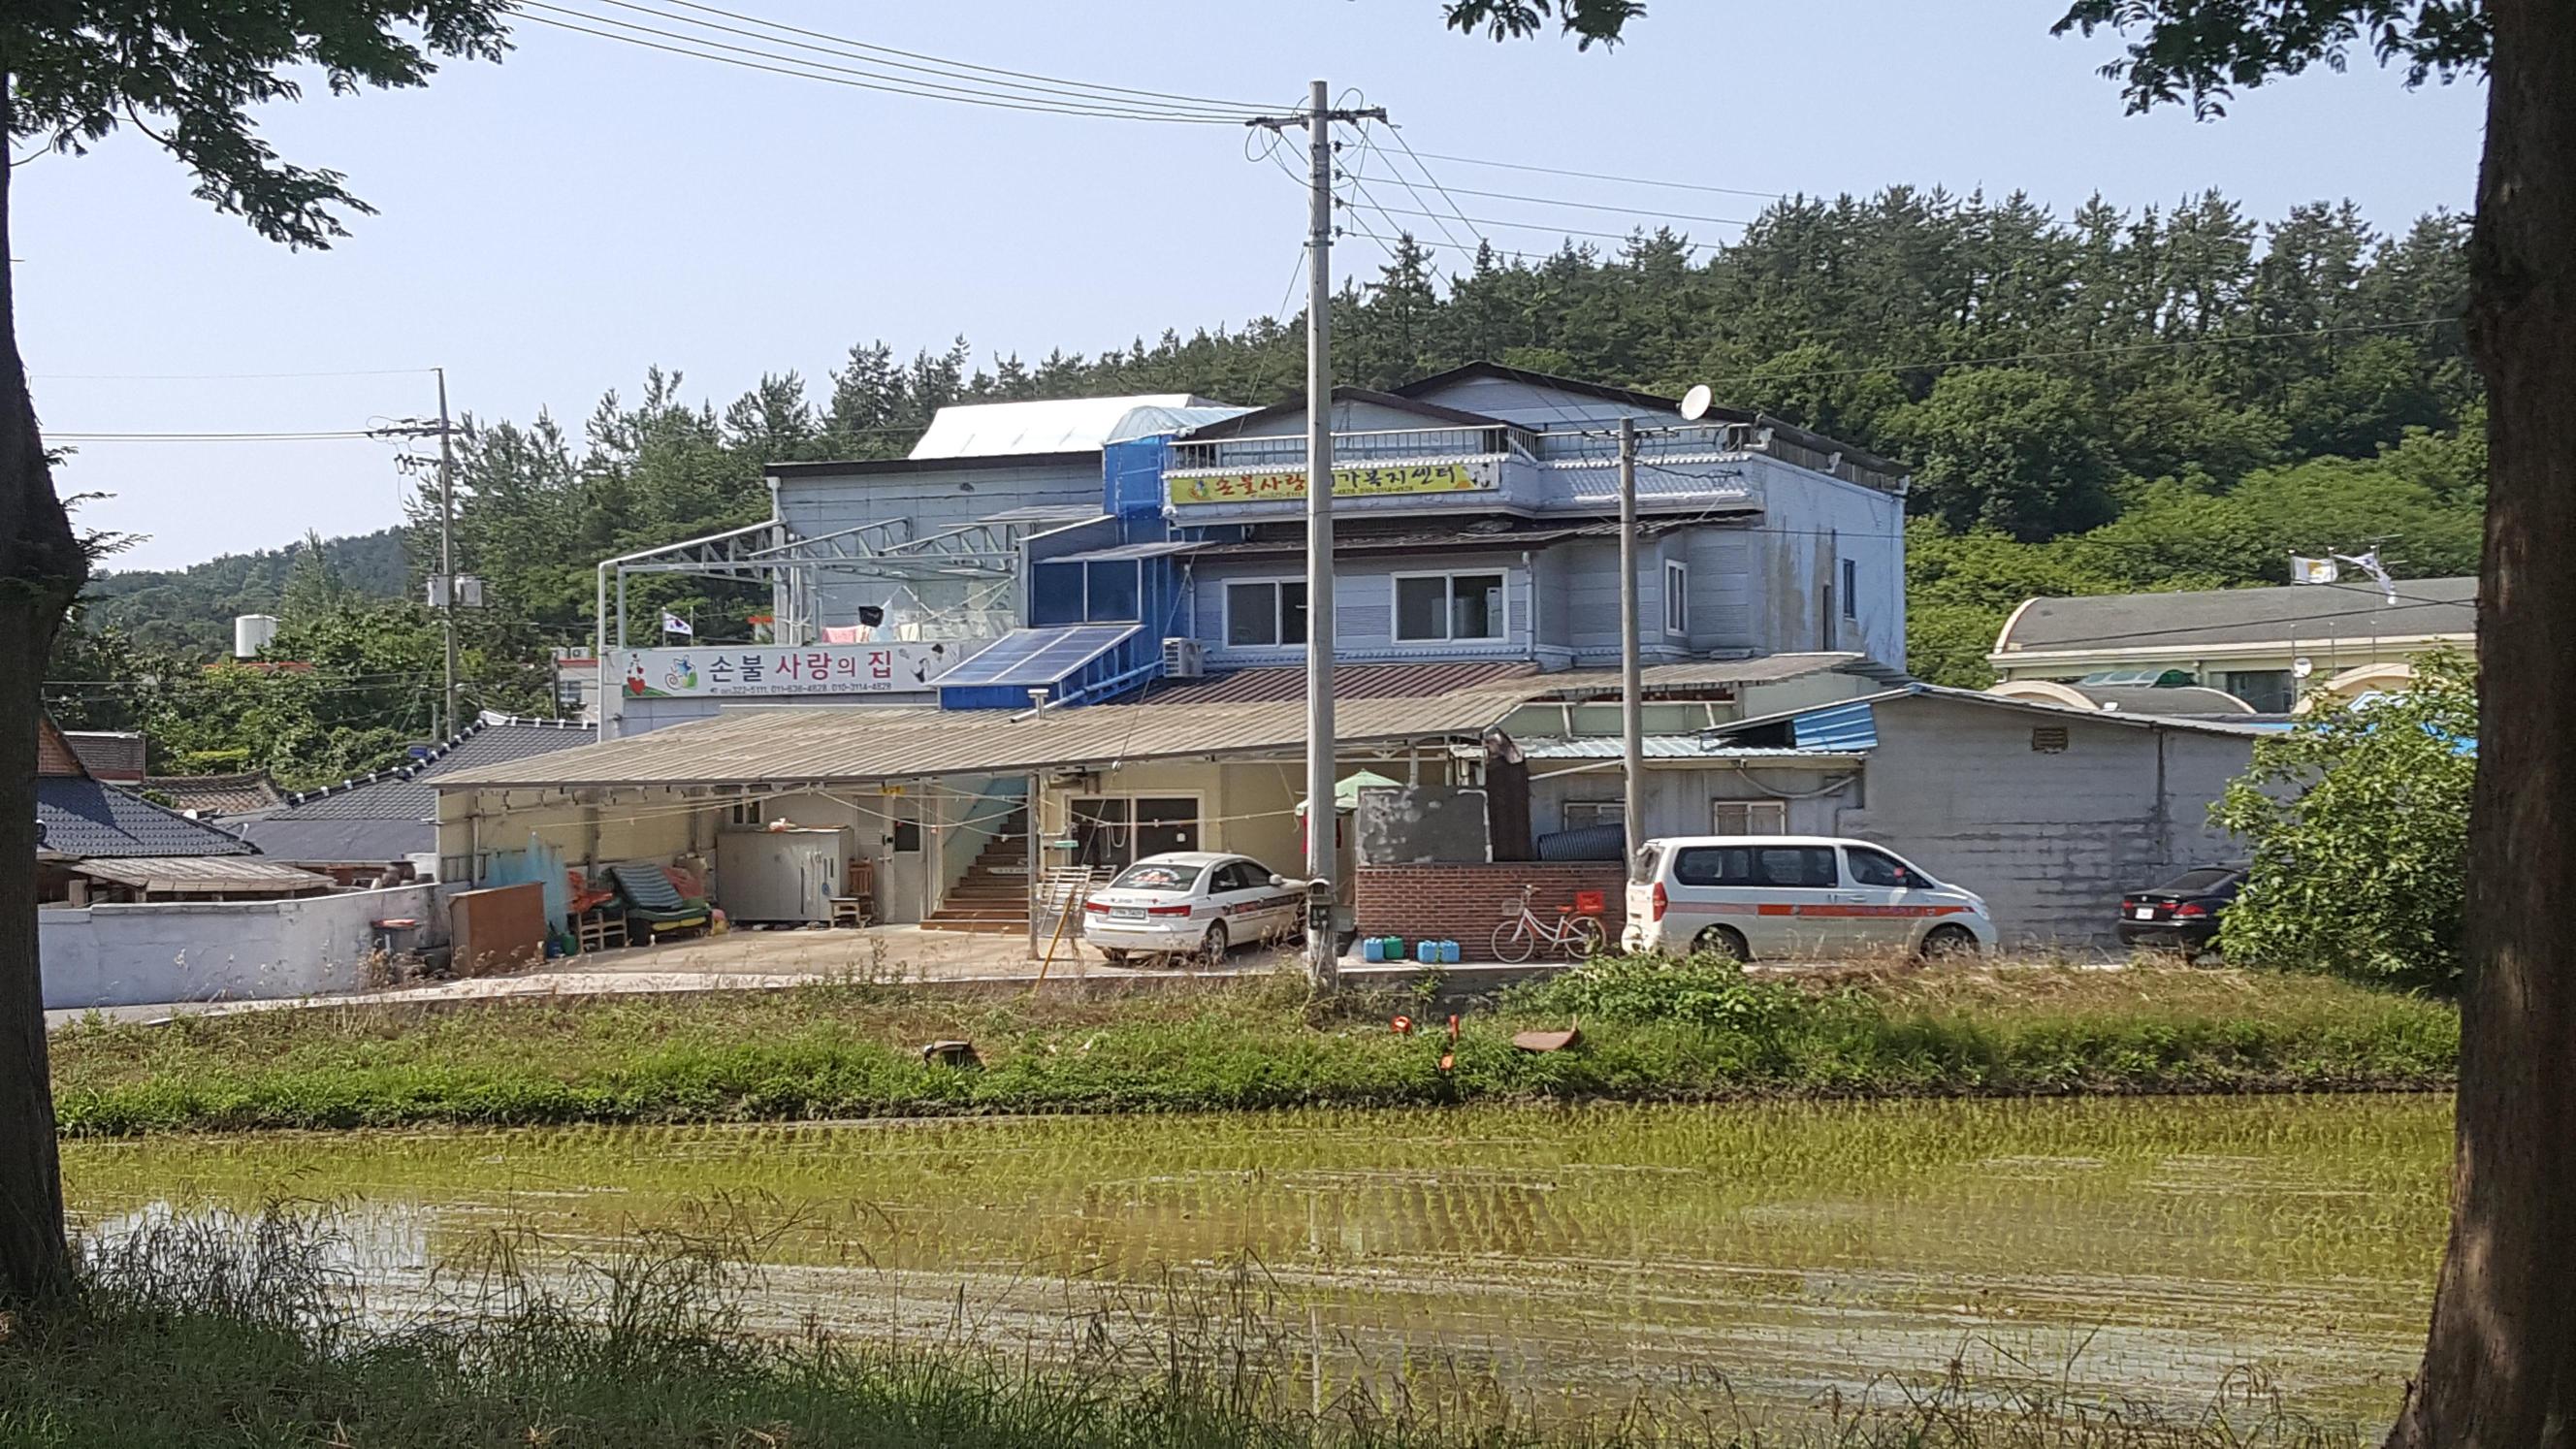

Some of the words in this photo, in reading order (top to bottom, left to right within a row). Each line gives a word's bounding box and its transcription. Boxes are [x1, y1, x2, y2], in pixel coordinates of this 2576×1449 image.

[1215, 473, 1305, 496] 손불사랑
[1332, 467, 1456, 488] 가복지센터
[709, 655, 765, 683] 손불
[775, 652, 856, 681] 사랑의
[868, 650, 892, 679] 집
